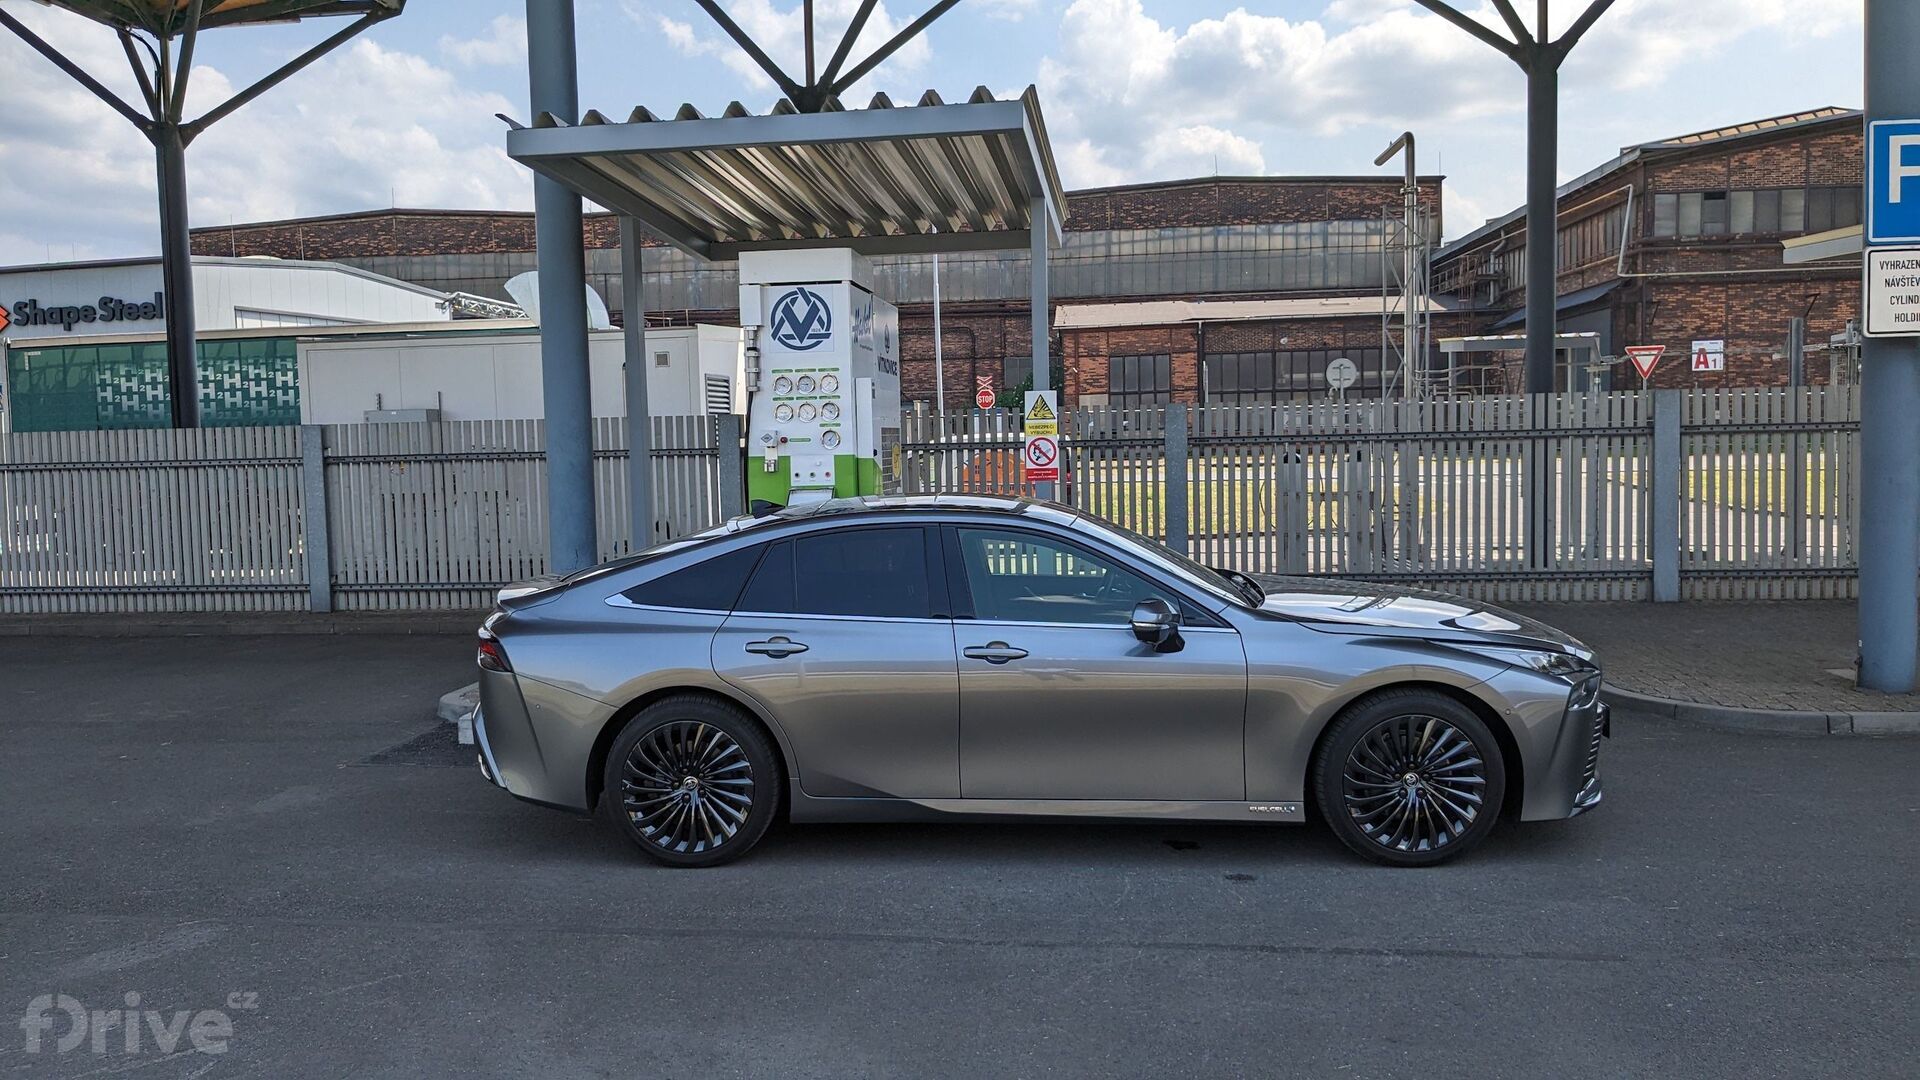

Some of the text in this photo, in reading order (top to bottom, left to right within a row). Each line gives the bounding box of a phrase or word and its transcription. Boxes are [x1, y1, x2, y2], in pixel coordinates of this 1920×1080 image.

[1879, 259, 1920, 270] VYHRAZEN
[1884, 274, 1920, 288] NÁVŠTĚV
[1890, 294, 1920, 306] CYLIND
[13, 292, 164, 331] Shape Steel
[1894, 312, 1920, 323] HOLDI
[978, 395, 993, 403] STOP
